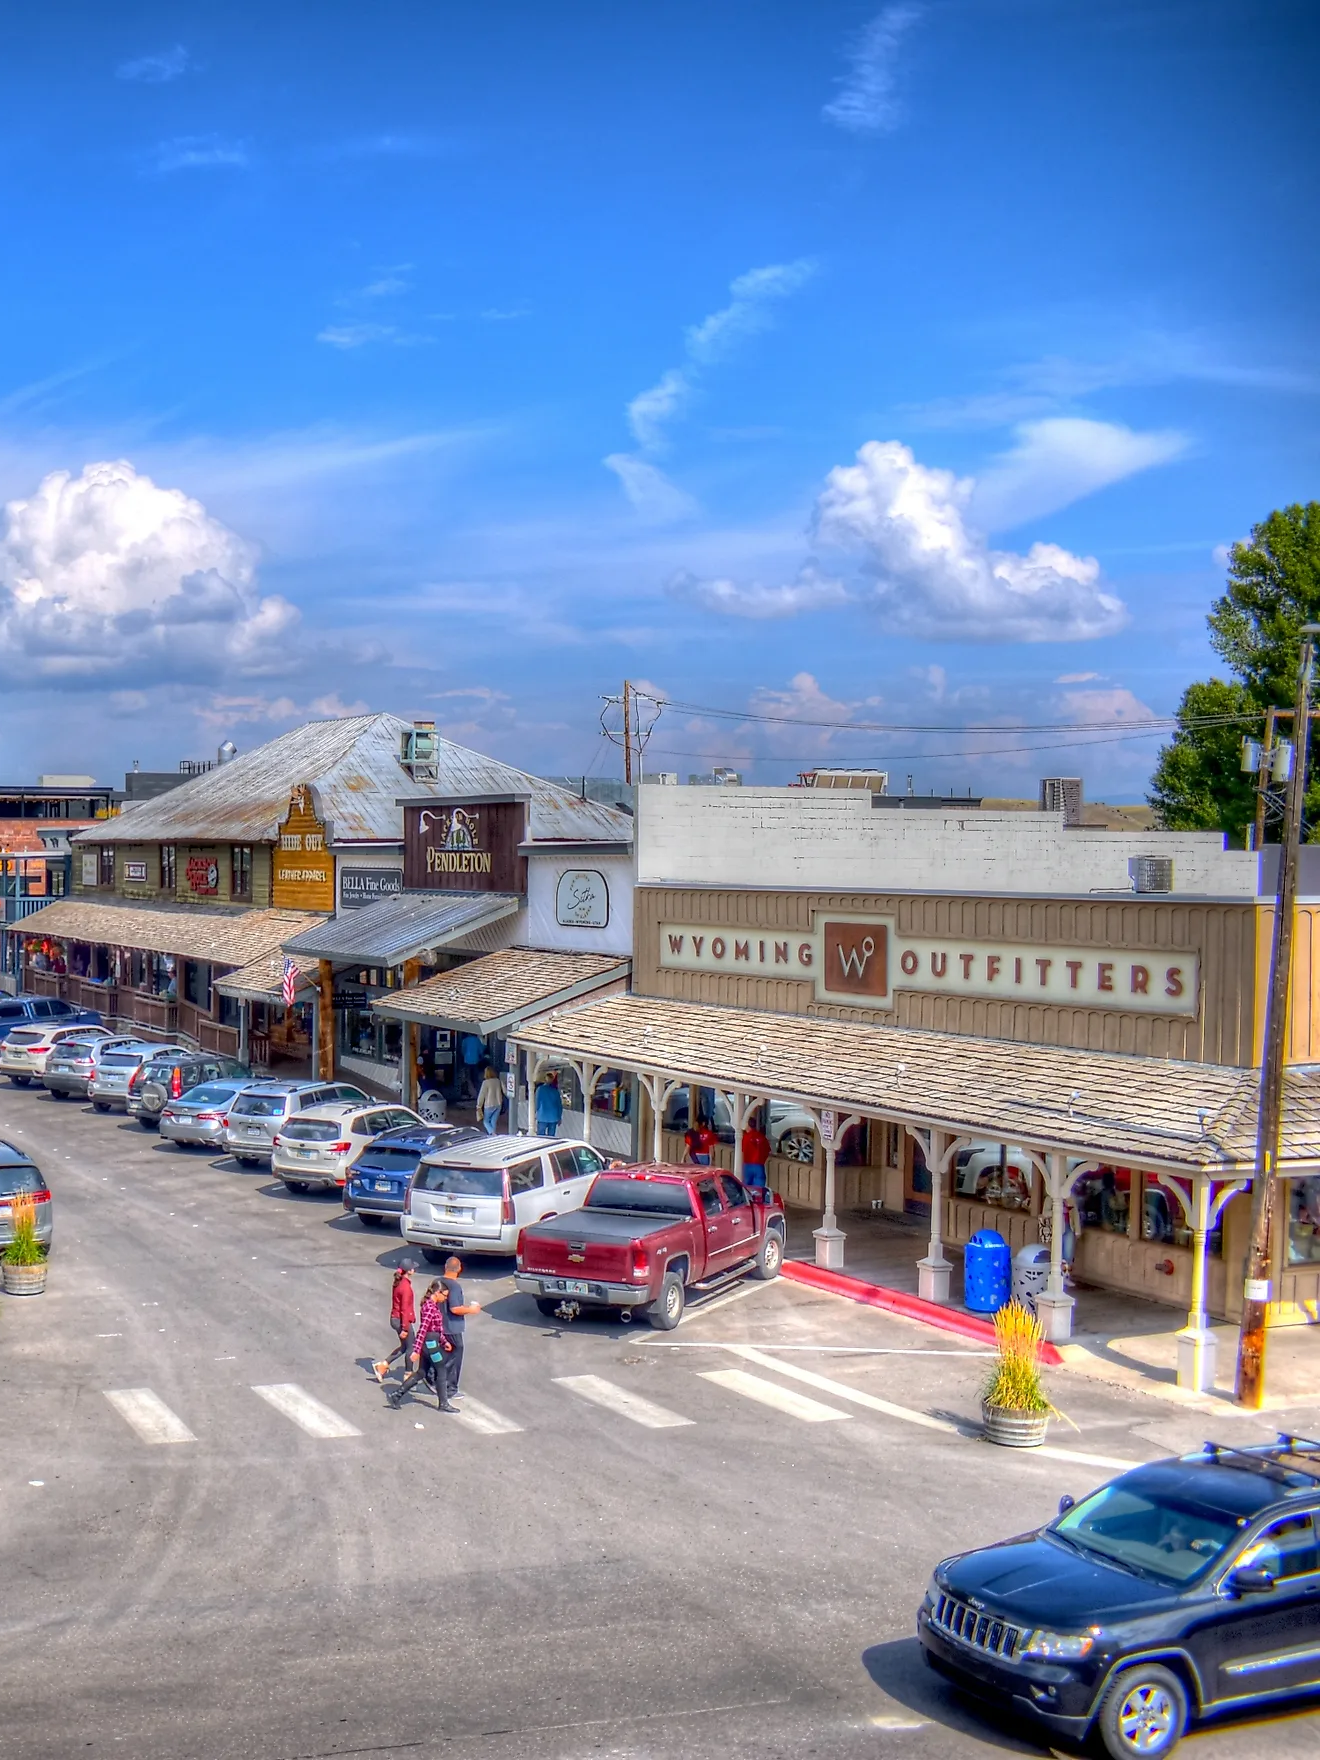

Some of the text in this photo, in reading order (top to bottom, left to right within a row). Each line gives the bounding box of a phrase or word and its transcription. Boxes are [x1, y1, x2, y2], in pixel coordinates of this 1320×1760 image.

[281, 834, 323, 851] HIDE OUT
[465, 817, 479, 845] HOLE
[426, 846, 491, 873] PENDLETON
[278, 869, 327, 882] LEATHER APPAREL
[342, 876, 401, 892] BELLA Fine Goods
[667, 933, 813, 967] WYOMING
[899, 949, 1184, 998] OUTFITTERS
